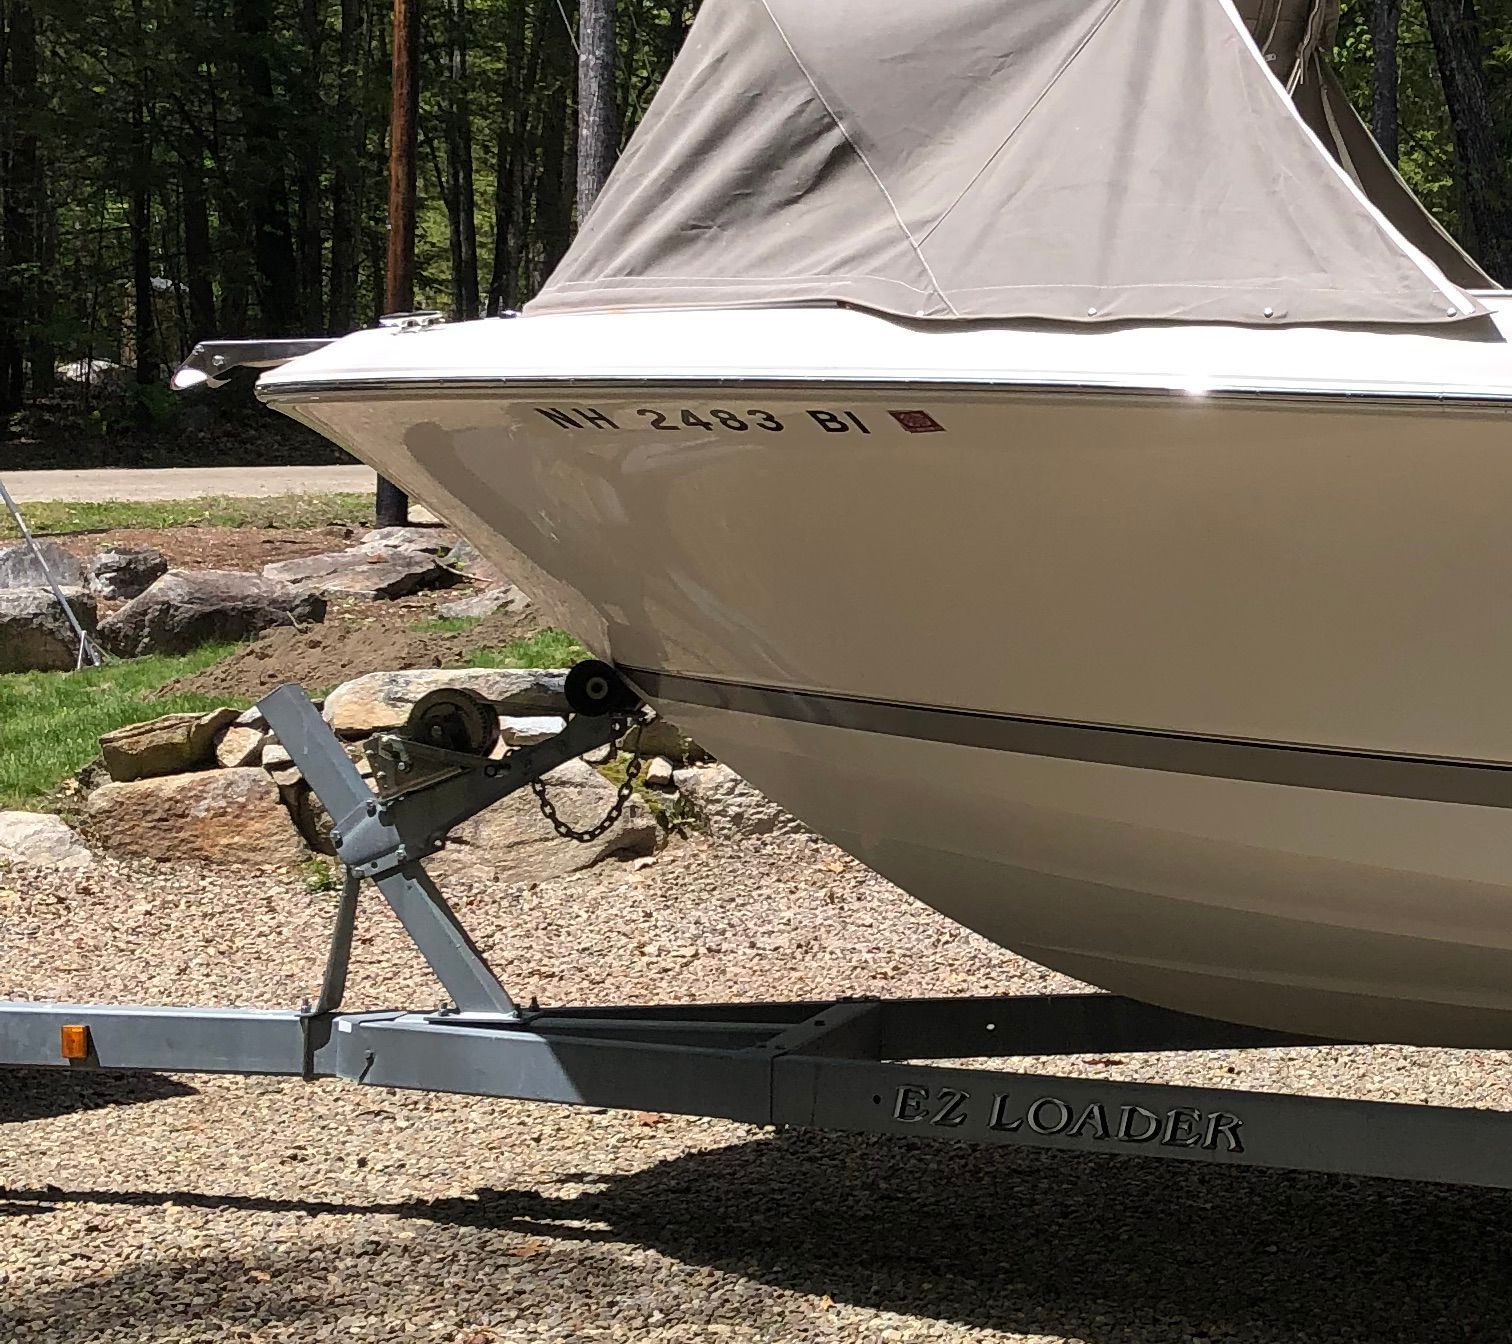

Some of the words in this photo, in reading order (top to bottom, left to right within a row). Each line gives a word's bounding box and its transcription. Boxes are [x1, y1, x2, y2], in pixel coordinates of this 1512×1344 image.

[534, 407, 621, 430] NH
[636, 408, 785, 433] 2483
[892, 1083, 971, 1128] EZ
[986, 1092, 1246, 1154] LOADER
